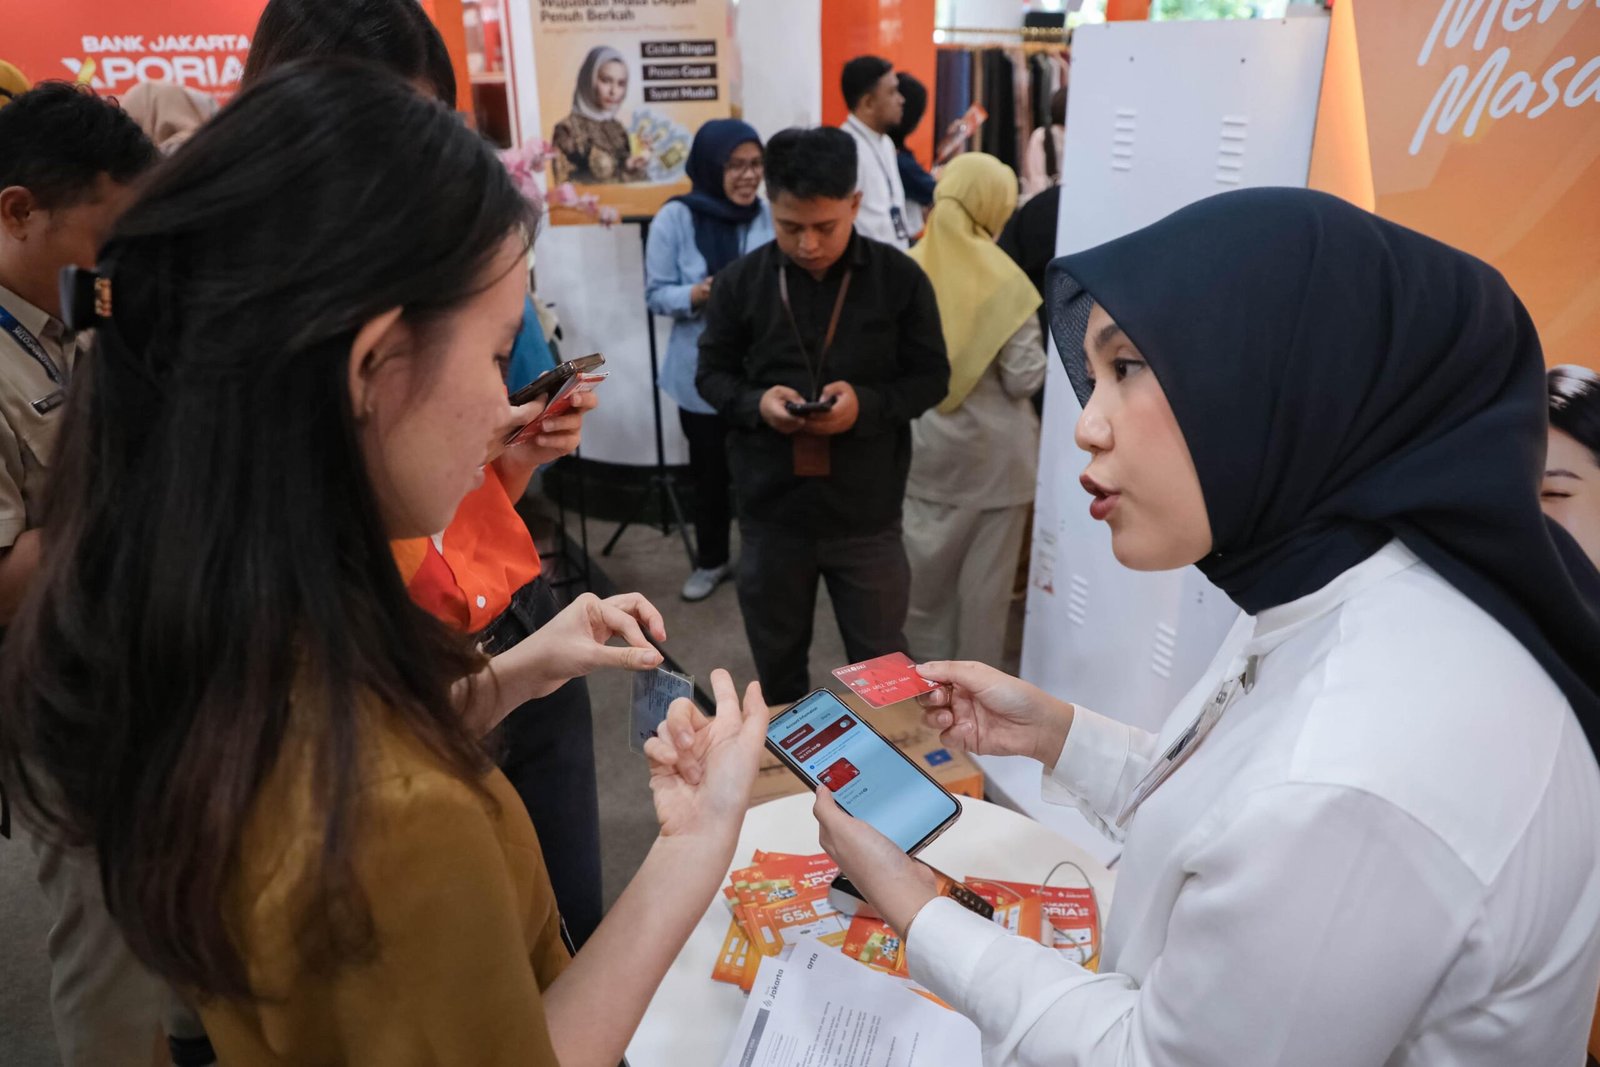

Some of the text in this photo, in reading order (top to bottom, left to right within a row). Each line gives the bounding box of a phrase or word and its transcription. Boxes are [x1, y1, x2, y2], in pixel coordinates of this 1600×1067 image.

[587, 10, 635, 21] Berkah
[81, 34, 250, 53] BANK JAKARTA
[782, 909, 814, 923] 65K
[806, 952, 819, 970] arta
[769, 968, 784, 999] Jakarta
